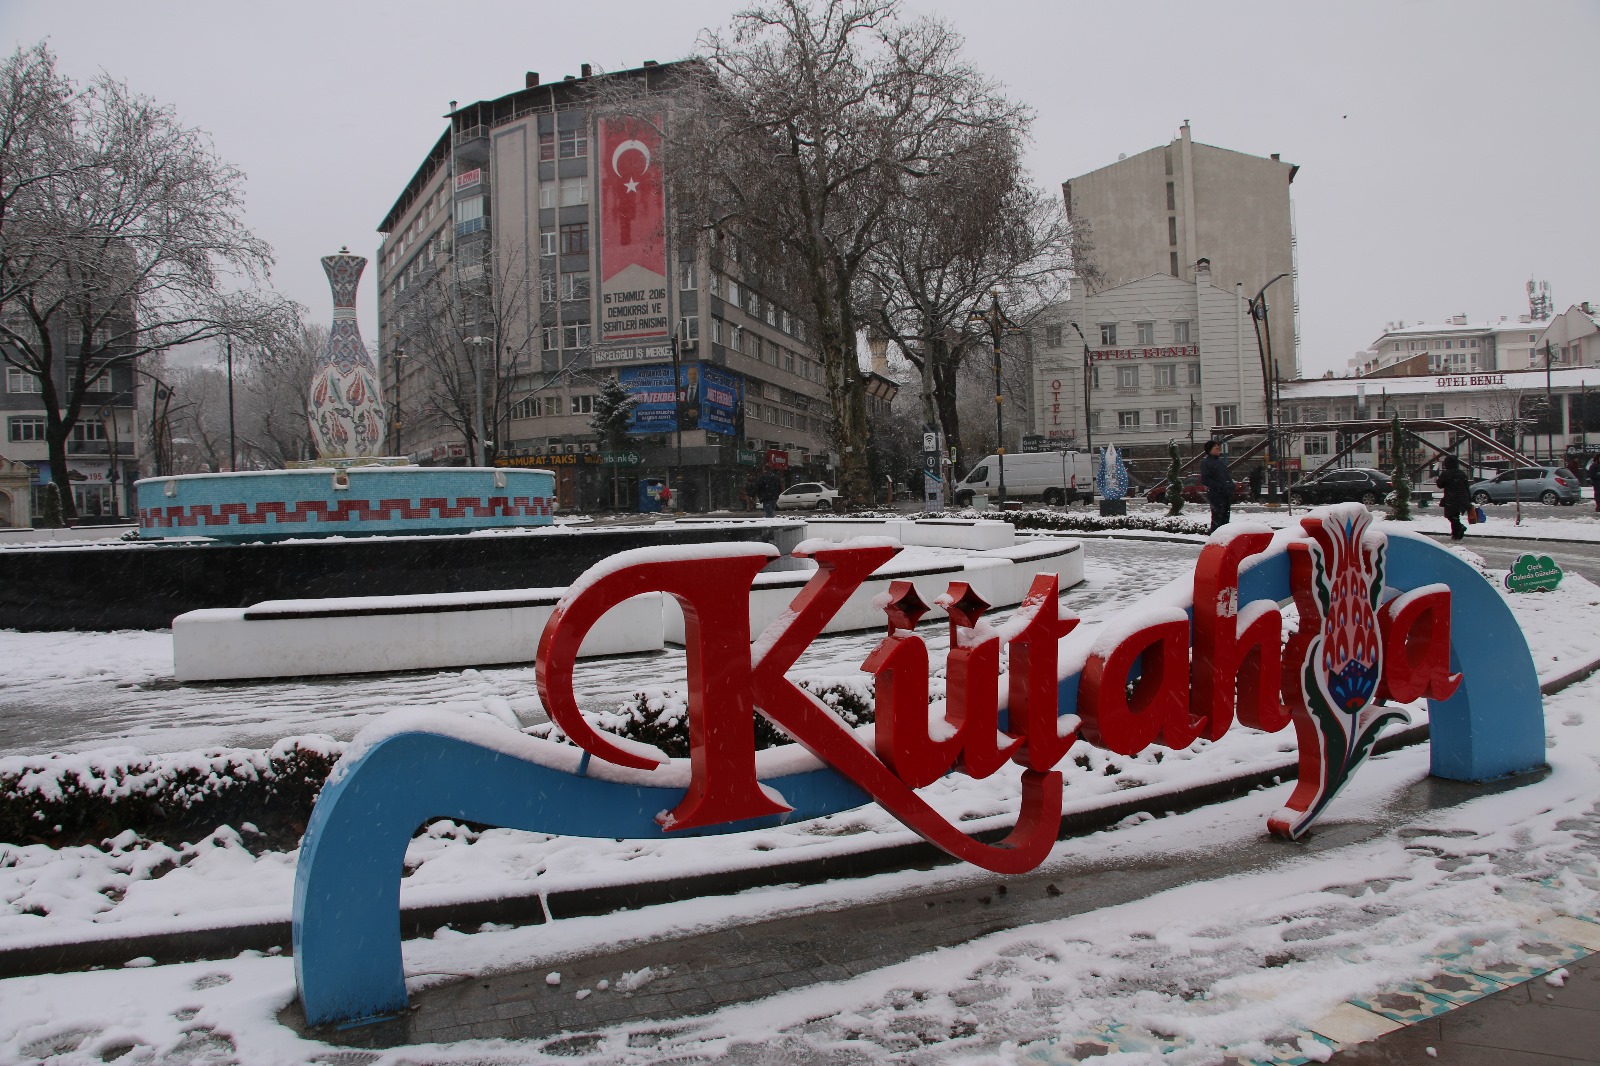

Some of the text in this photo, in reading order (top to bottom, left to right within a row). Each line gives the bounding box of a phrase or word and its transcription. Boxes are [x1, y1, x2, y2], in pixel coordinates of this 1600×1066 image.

[603, 288, 666, 304] 15 TEMMUZ 2016
[608, 302, 661, 318] DEMOKRASİ VE
[638, 317, 667, 329] ANISINA
[1089, 342, 1199, 362] OTEL BENLİ
[1437, 374, 1504, 387] OTEL BENLİ
[1052, 379, 1061, 425] OTEL
[515, 456, 546, 465] MURAT
